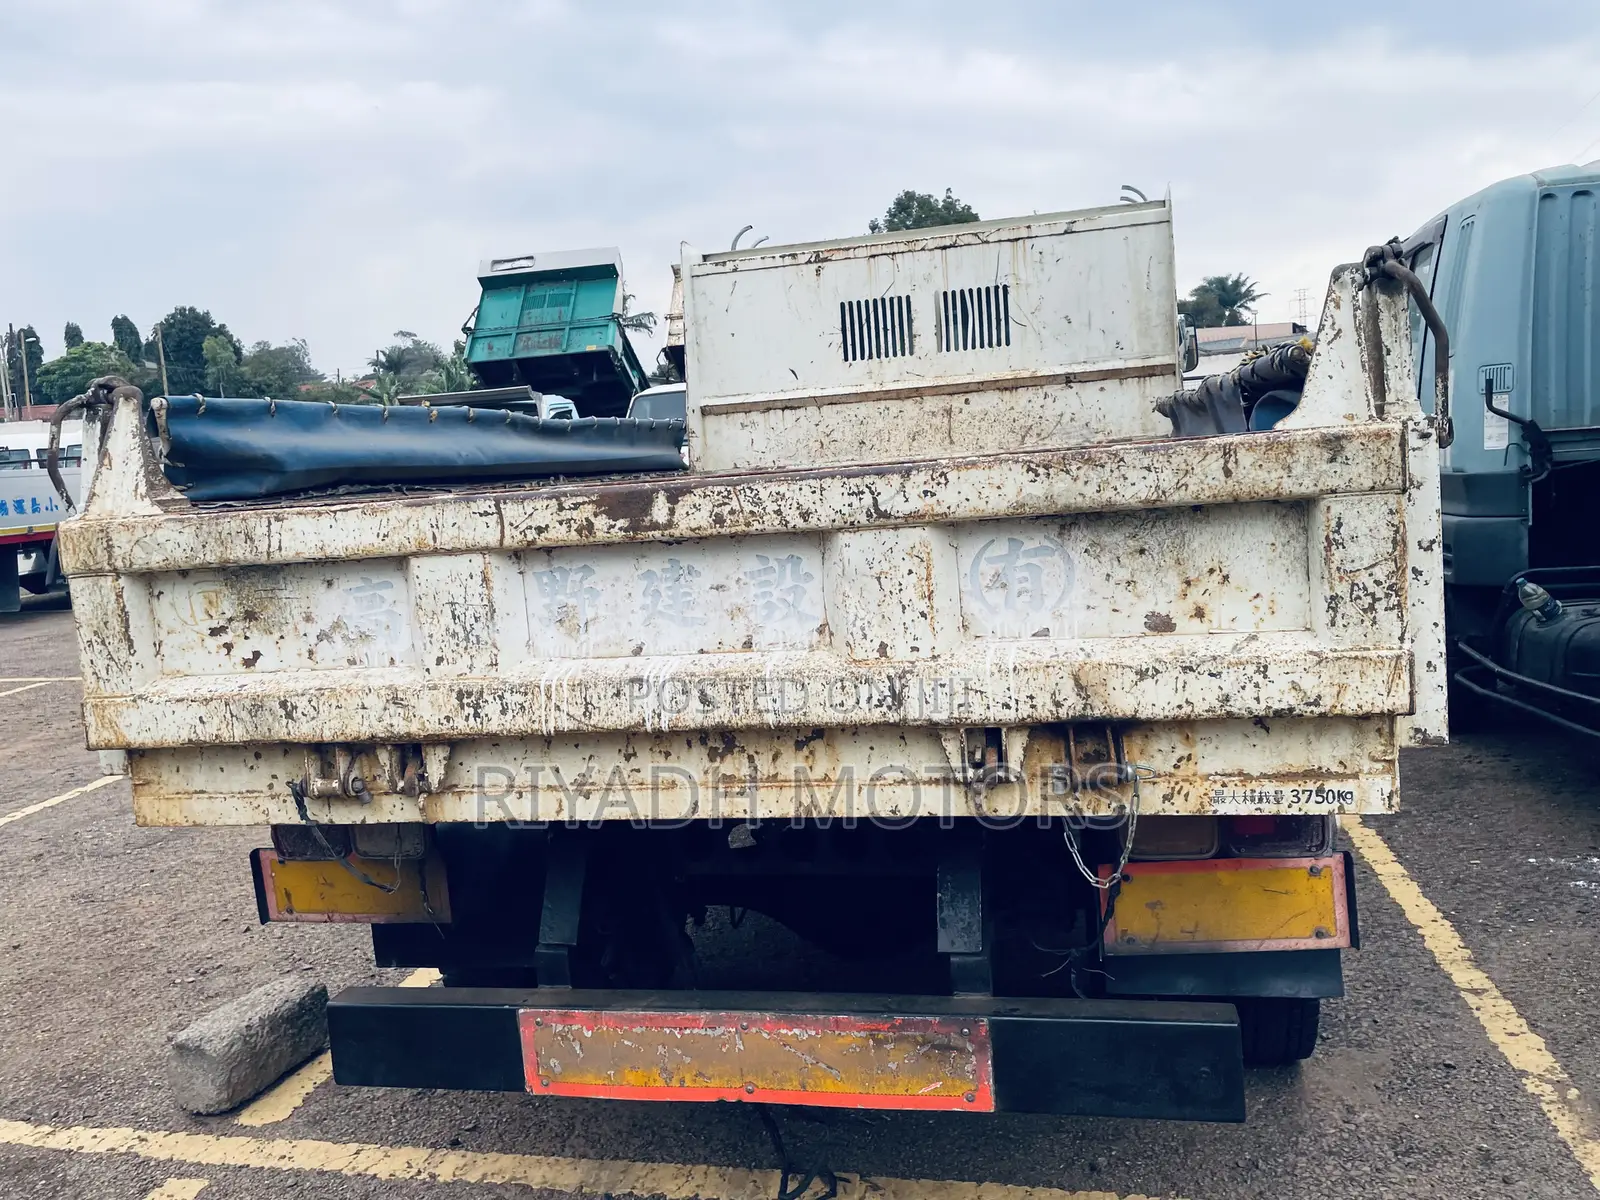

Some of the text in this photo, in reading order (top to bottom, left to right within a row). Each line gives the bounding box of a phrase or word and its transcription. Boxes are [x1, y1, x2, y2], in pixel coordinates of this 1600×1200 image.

[1211, 789, 1285, 805] 最大積載量
